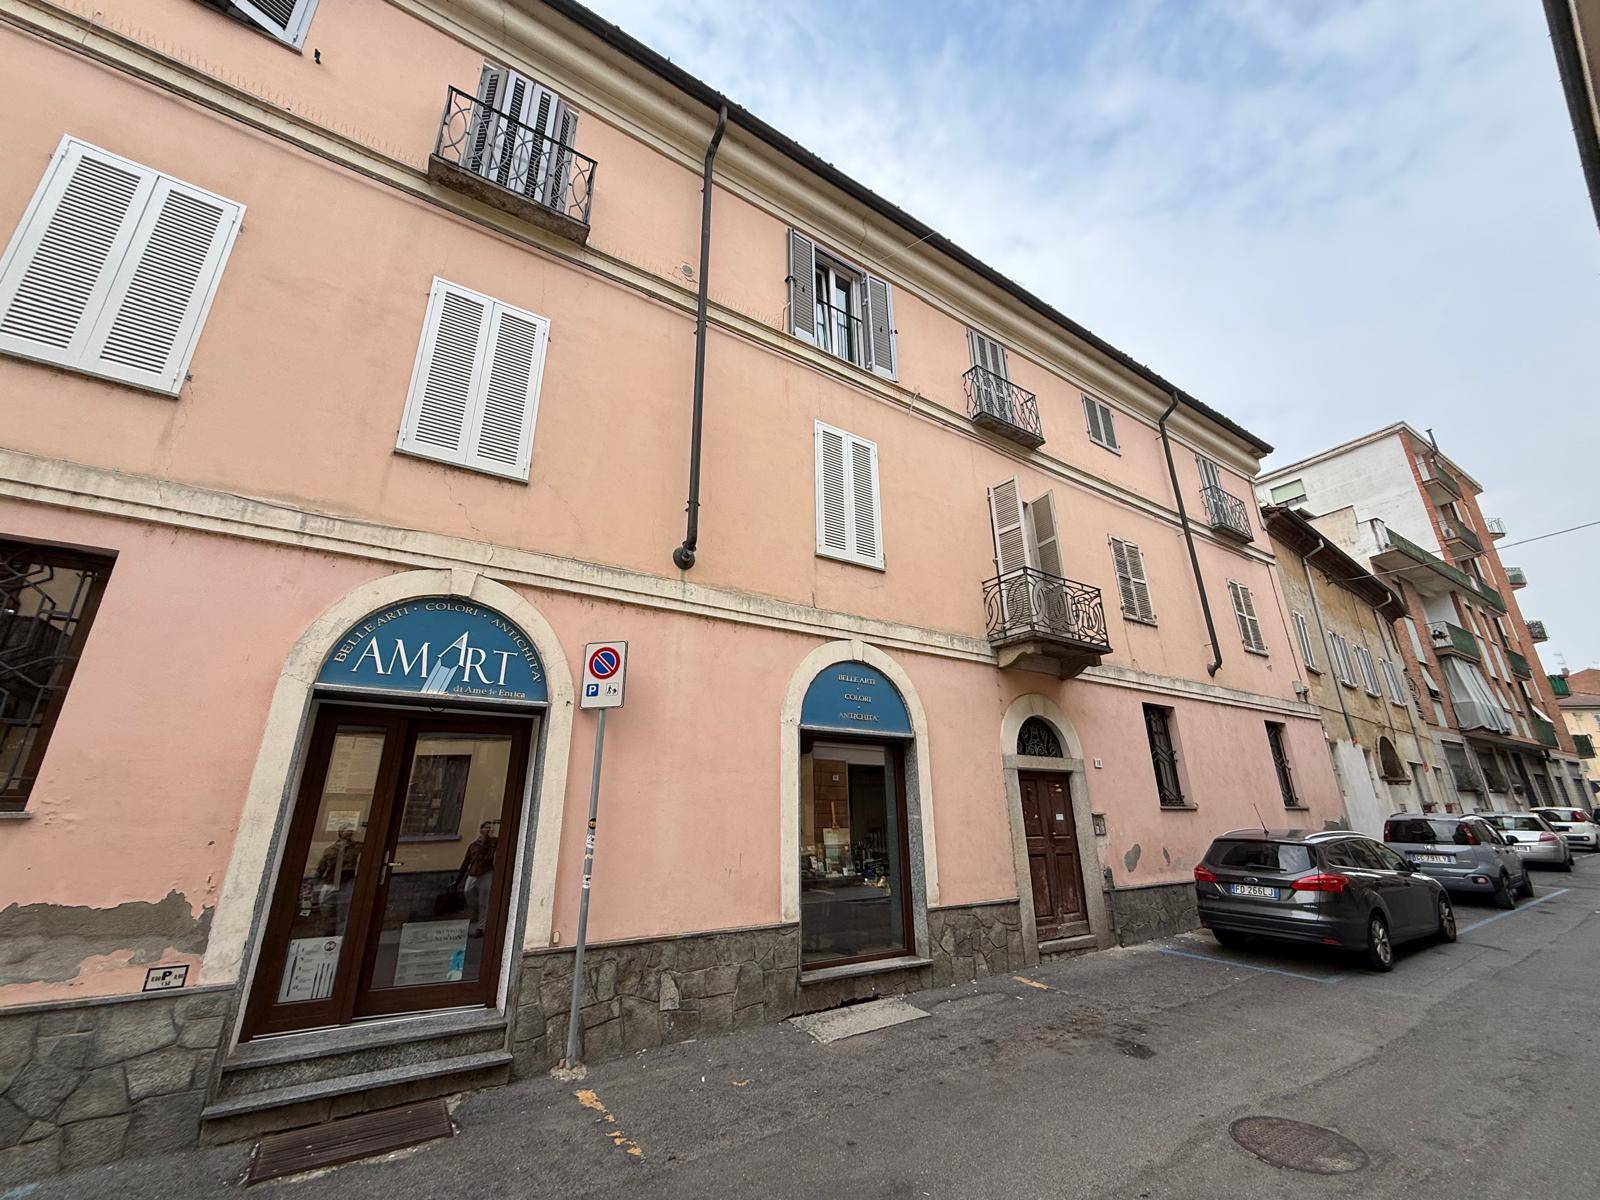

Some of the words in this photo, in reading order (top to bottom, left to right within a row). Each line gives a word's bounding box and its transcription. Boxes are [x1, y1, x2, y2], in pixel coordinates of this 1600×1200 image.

[333, 623, 376, 663] BELLE
[377, 607, 409, 627] ARTI
[425, 602, 478, 616] COLORI
[838, 674, 859, 683] BELLE
[859, 677, 876, 685] ARTI
[588, 685, 597, 696] P
[844, 693, 872, 702] COLORI
[161, 970, 173, 981] P
